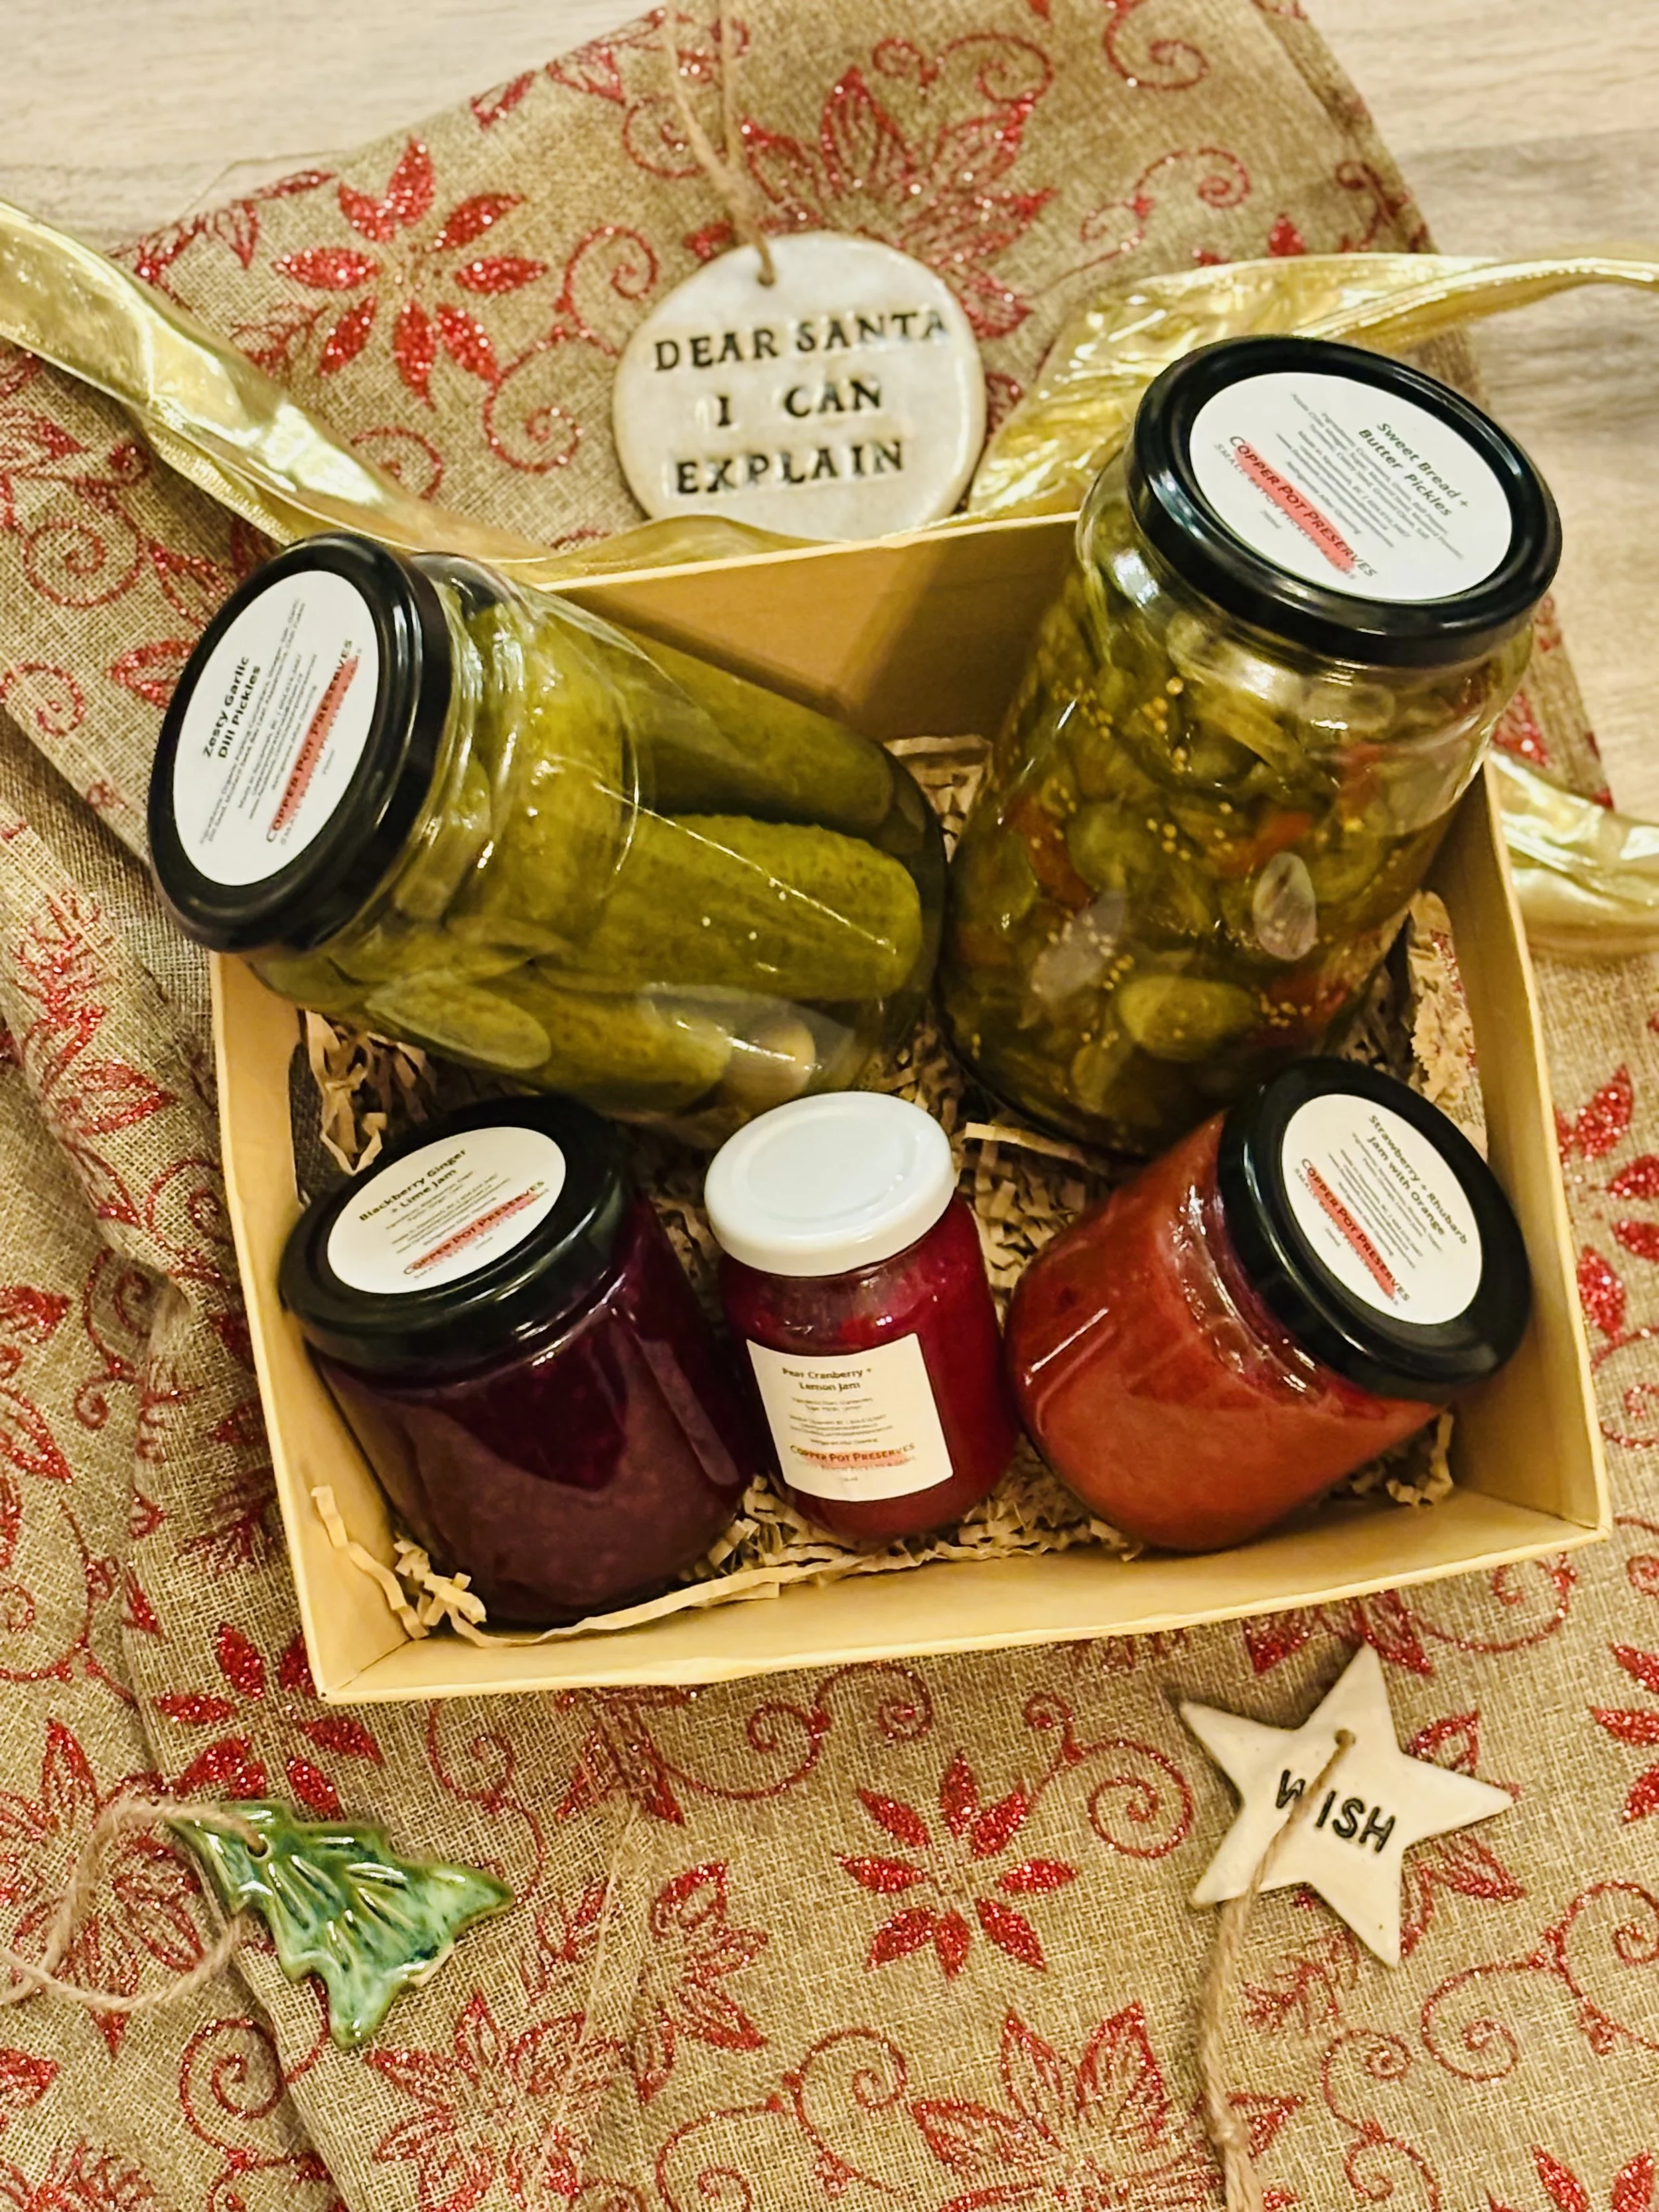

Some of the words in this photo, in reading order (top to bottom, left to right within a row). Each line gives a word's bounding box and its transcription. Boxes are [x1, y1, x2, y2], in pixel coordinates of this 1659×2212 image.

[654, 328, 779, 372] DEAR
[796, 309, 947, 353] SANTA
[716, 395, 732, 427] I
[783, 378, 883, 418] CAN
[676, 440, 904, 494] EXPLAIN
[1358, 429, 1403, 468] Butter
[1404, 473, 1451, 516] Pickles
[1377, 423, 1419, 461] Sweet
[1417, 462, 1460, 498] Bread
[1229, 435, 1279, 484] COPPER
[1277, 484, 1307, 508] POT
[1304, 511, 1376, 576] PRESERVES
[202, 710, 228, 757] Zesty
[224, 657, 248, 707] Garlic
[218, 729, 234, 758] Dill
[231, 666, 260, 725] Pickles
[265, 776, 298, 842] COPPER
[293, 739, 313, 771] POT
[309, 640, 352, 734] PRESERVES
[359, 1177, 425, 1220] Blackberry
[426, 1149, 465, 1177] Ginger
[400, 1187, 431, 1207] Lime
[431, 1169, 456, 1188] Jam
[1366, 1137, 1388, 1161] Jam
[1388, 1161, 1410, 1190] with
[1410, 1191, 1445, 1235] Orange
[1369, 1115, 1420, 1181] Strawberry
[1427, 1193, 1467, 1244] Rhubarb
[452, 1226, 476, 1243] POT
[1301, 1158, 1338, 1207] COPPER
[1337, 1207, 1358, 1231] POT
[1357, 1233, 1409, 1301] PRESERVES
[798, 1382, 836, 1390] Lemon
[838, 1382, 860, 1392] Jam
[807, 1369, 863, 1379] Cranberry
[1275, 1769, 1396, 1854] WISH
